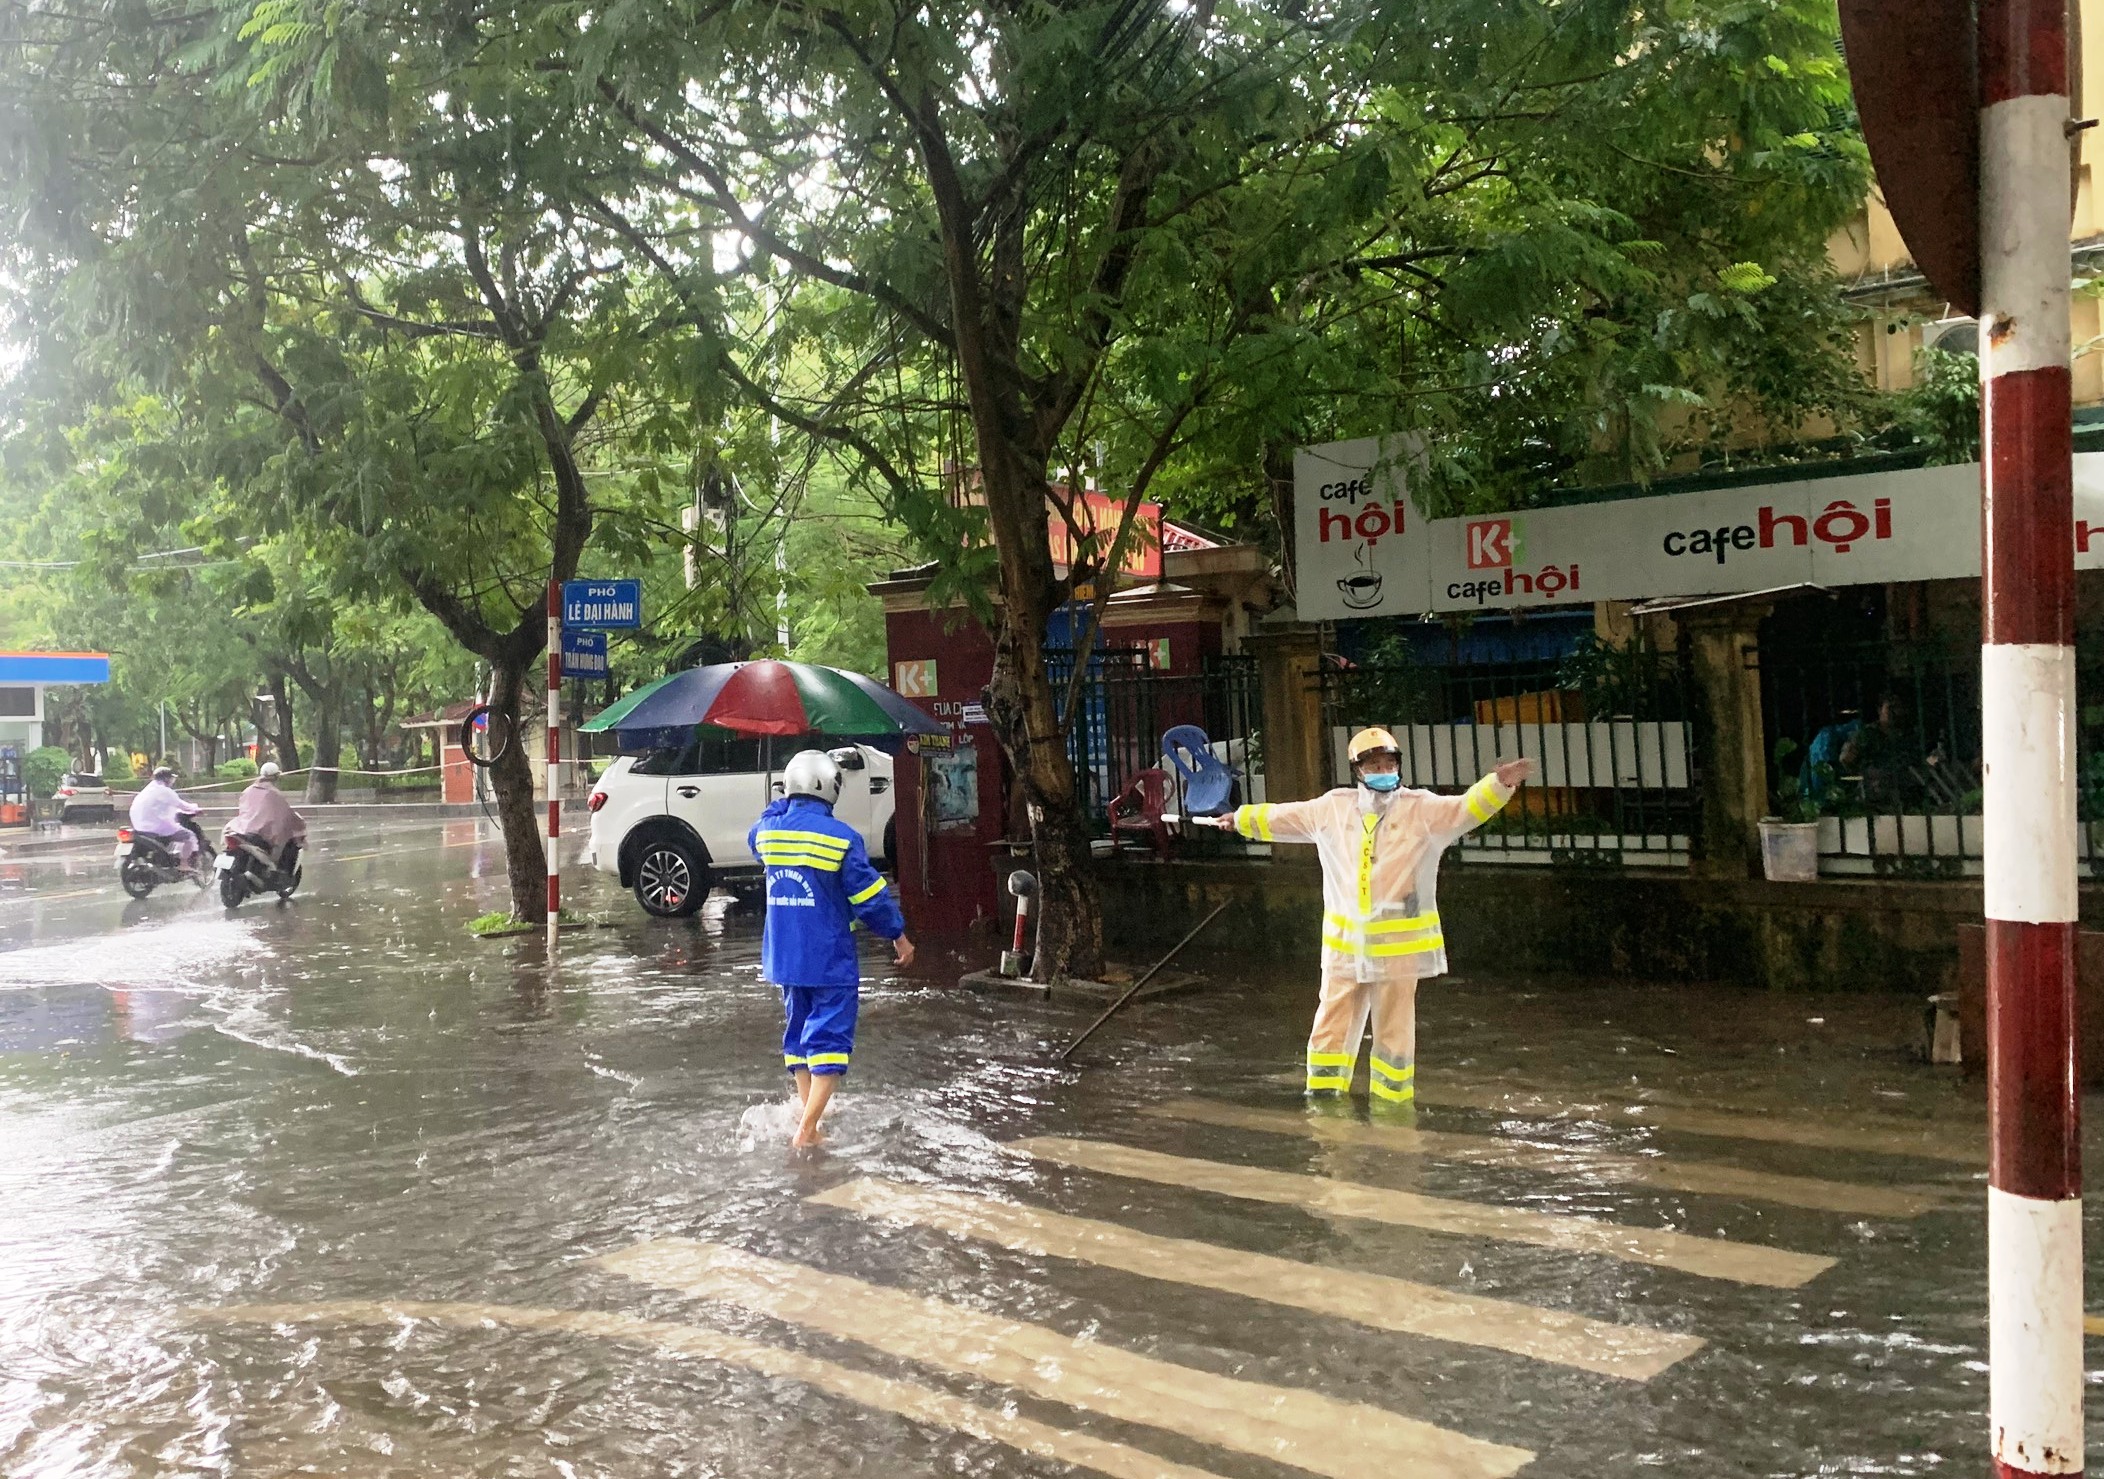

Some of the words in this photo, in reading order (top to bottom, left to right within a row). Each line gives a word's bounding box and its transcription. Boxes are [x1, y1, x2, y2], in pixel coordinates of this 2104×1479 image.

[1319, 500, 1405, 546] hội
[588, 583, 616, 597] PHỐ
[568, 600, 582, 621] LÊ
[584, 603, 602, 624] ĐẠI
[604, 599, 633, 620] HÀNH
[900, 664, 933, 695] K+
